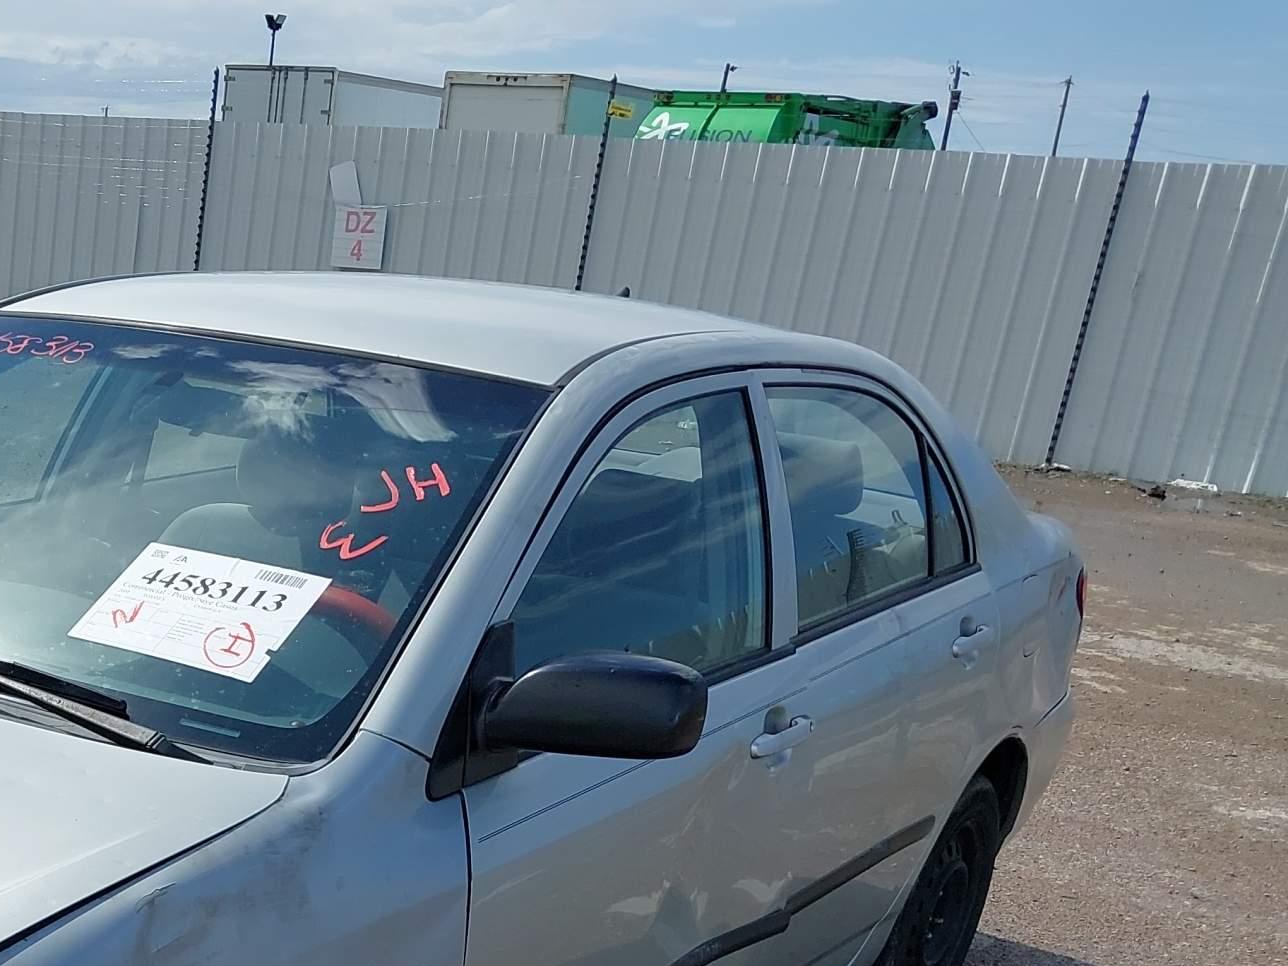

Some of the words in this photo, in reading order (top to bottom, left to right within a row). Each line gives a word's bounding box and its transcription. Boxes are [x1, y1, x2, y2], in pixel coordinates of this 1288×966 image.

[344, 210, 377, 234] DZ
[350, 239, 363, 262] 4
[141, 567, 288, 612] 44583113
